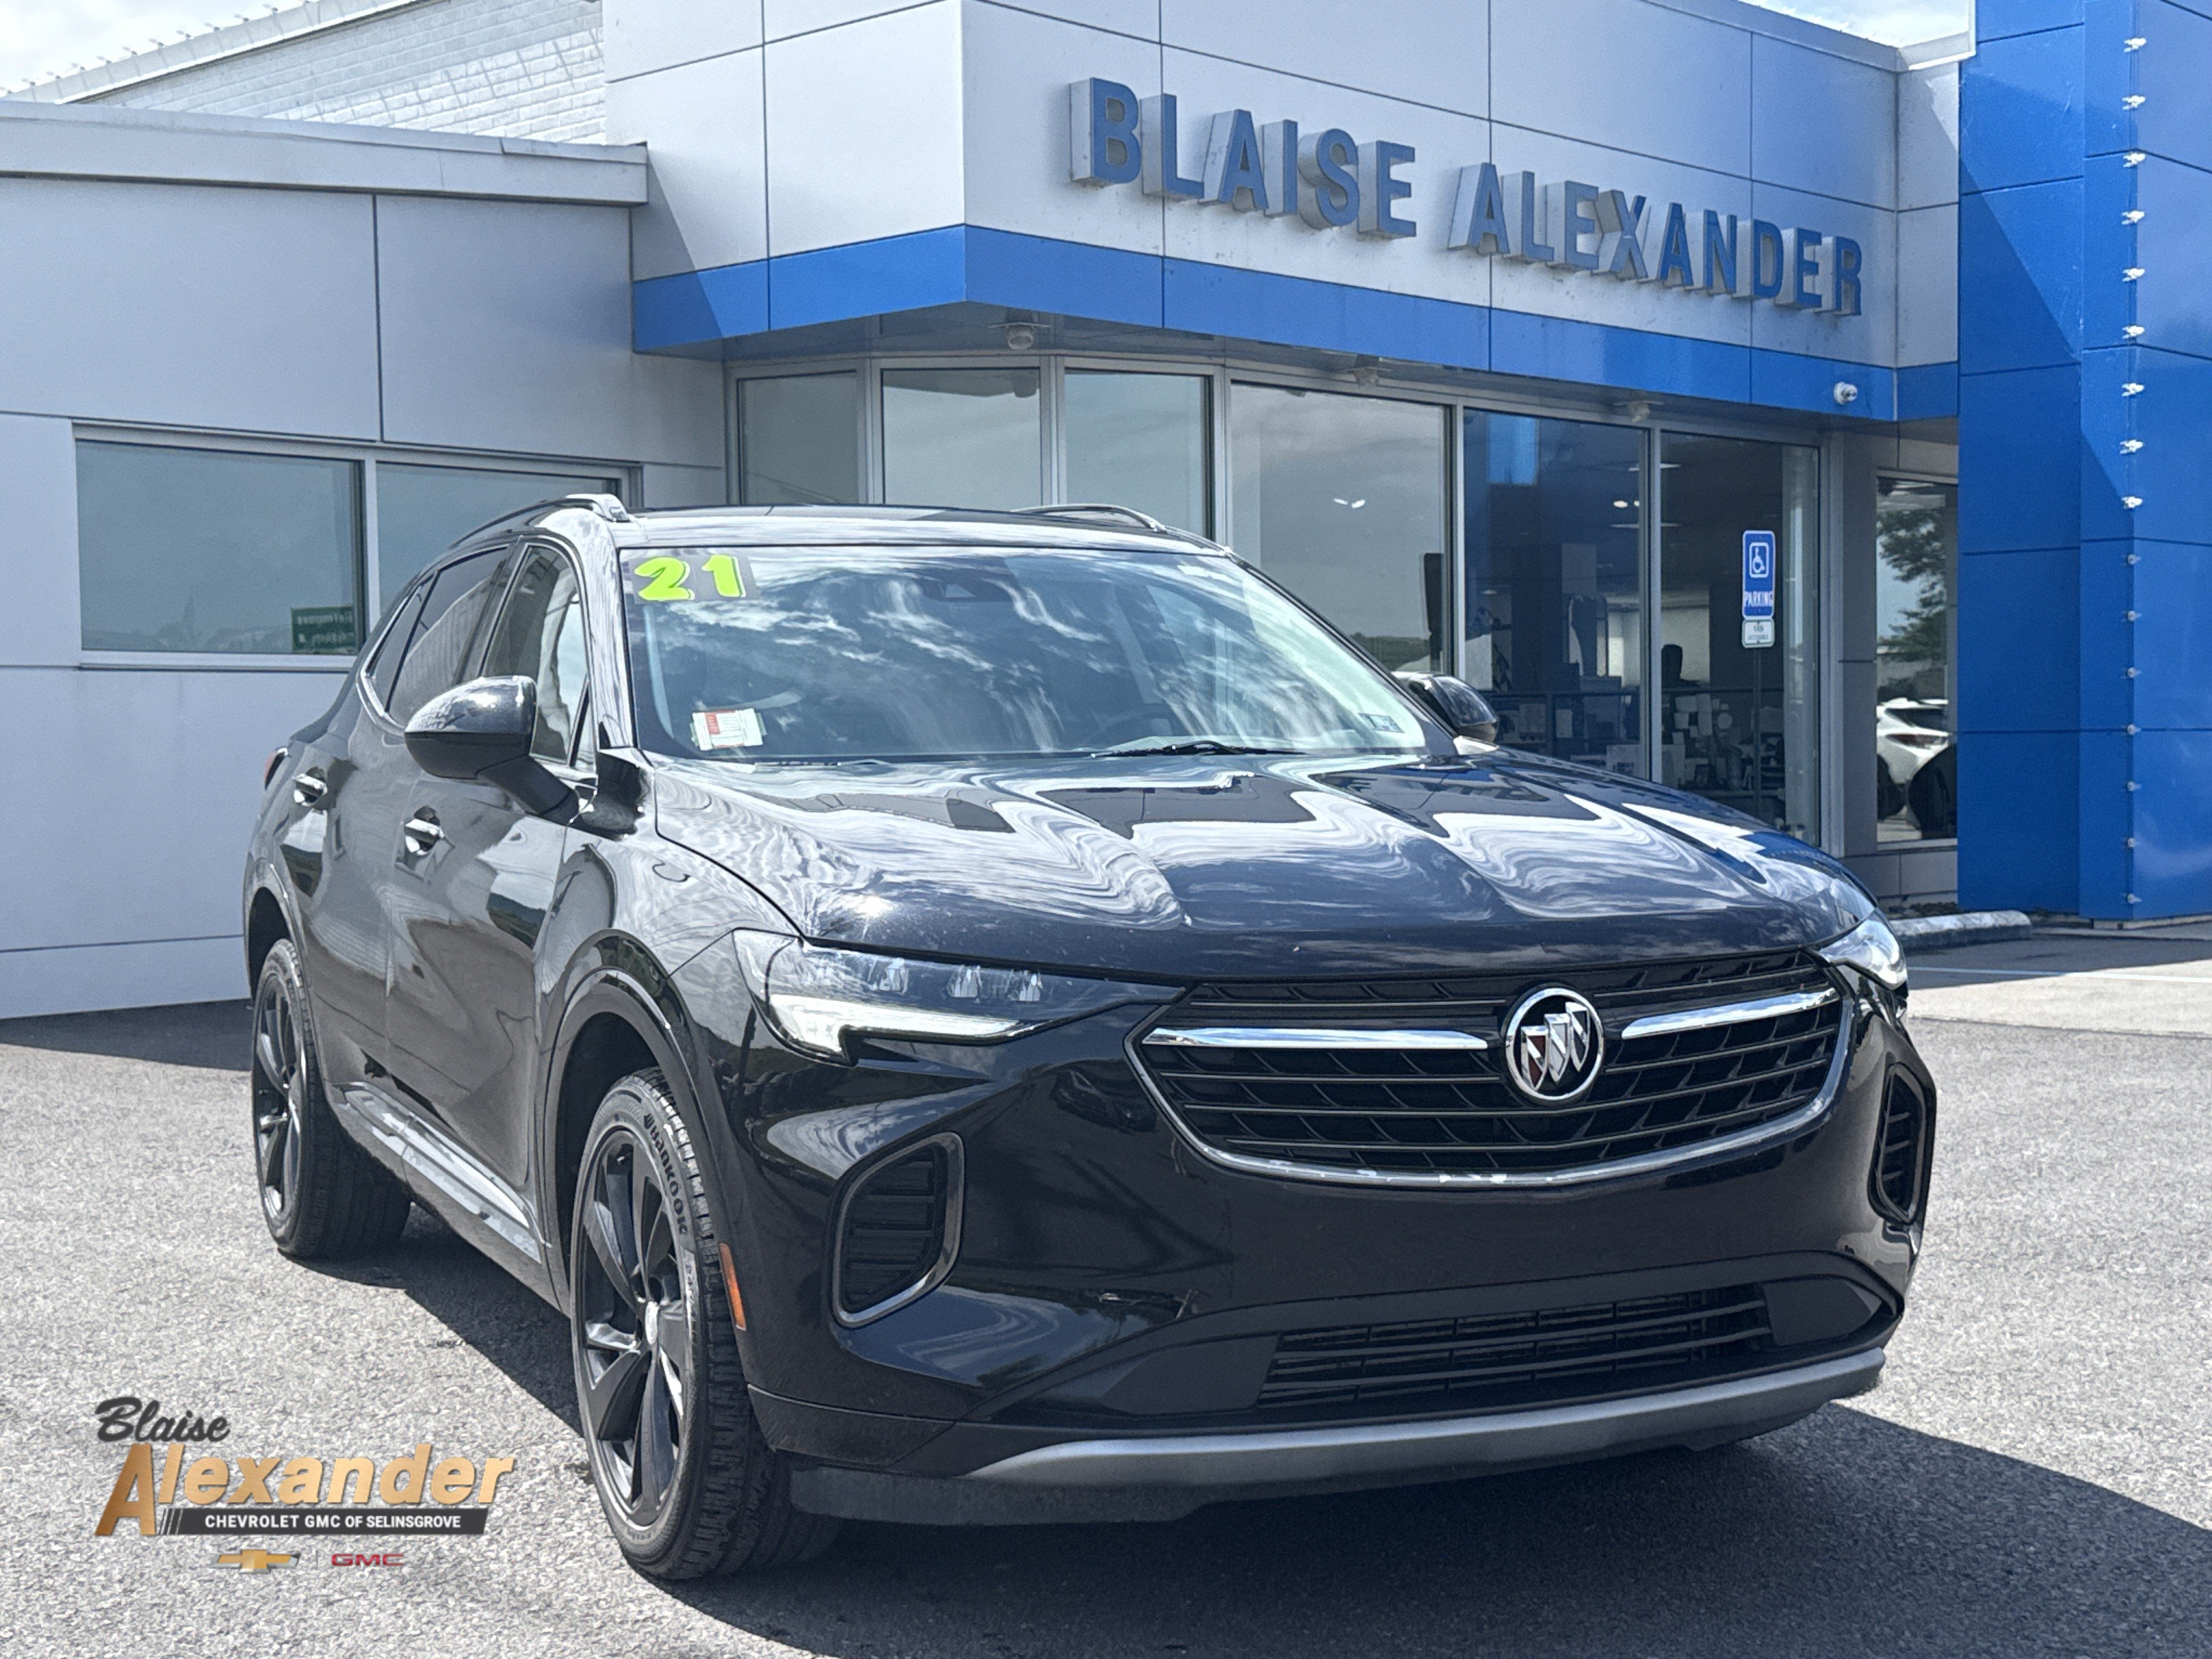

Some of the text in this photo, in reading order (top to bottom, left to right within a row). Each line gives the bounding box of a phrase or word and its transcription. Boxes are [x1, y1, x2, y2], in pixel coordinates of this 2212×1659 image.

[1070, 77, 1862, 316] BLAISE ALEXANDER
[634, 554, 746, 601] 21
